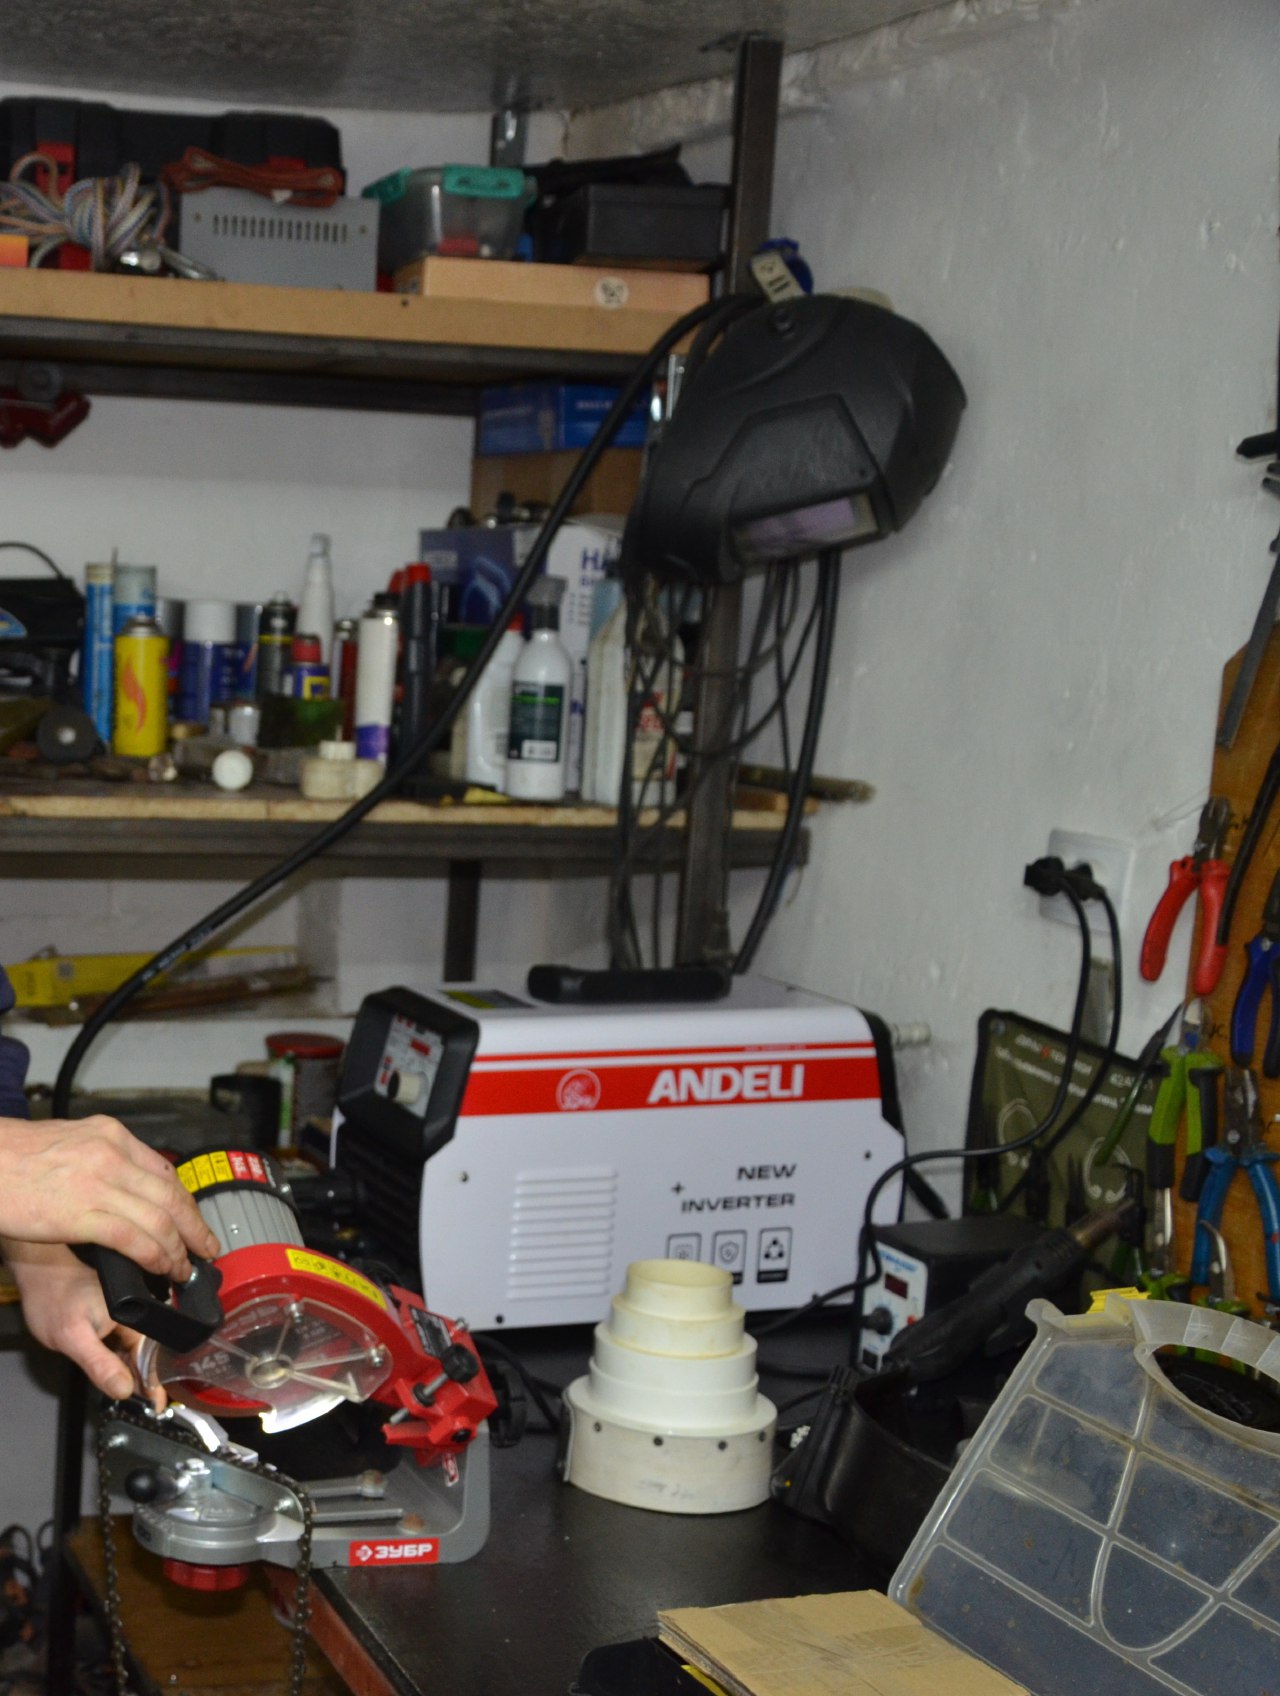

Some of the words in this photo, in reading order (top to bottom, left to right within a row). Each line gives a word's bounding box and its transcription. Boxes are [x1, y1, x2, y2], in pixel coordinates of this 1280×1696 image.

[646, 1063, 805, 1104] ANDELI
[737, 1162, 797, 1181] NEW
[681, 1192, 796, 1213] INVERTER
[374, 1542, 433, 1559] ЗУБР
